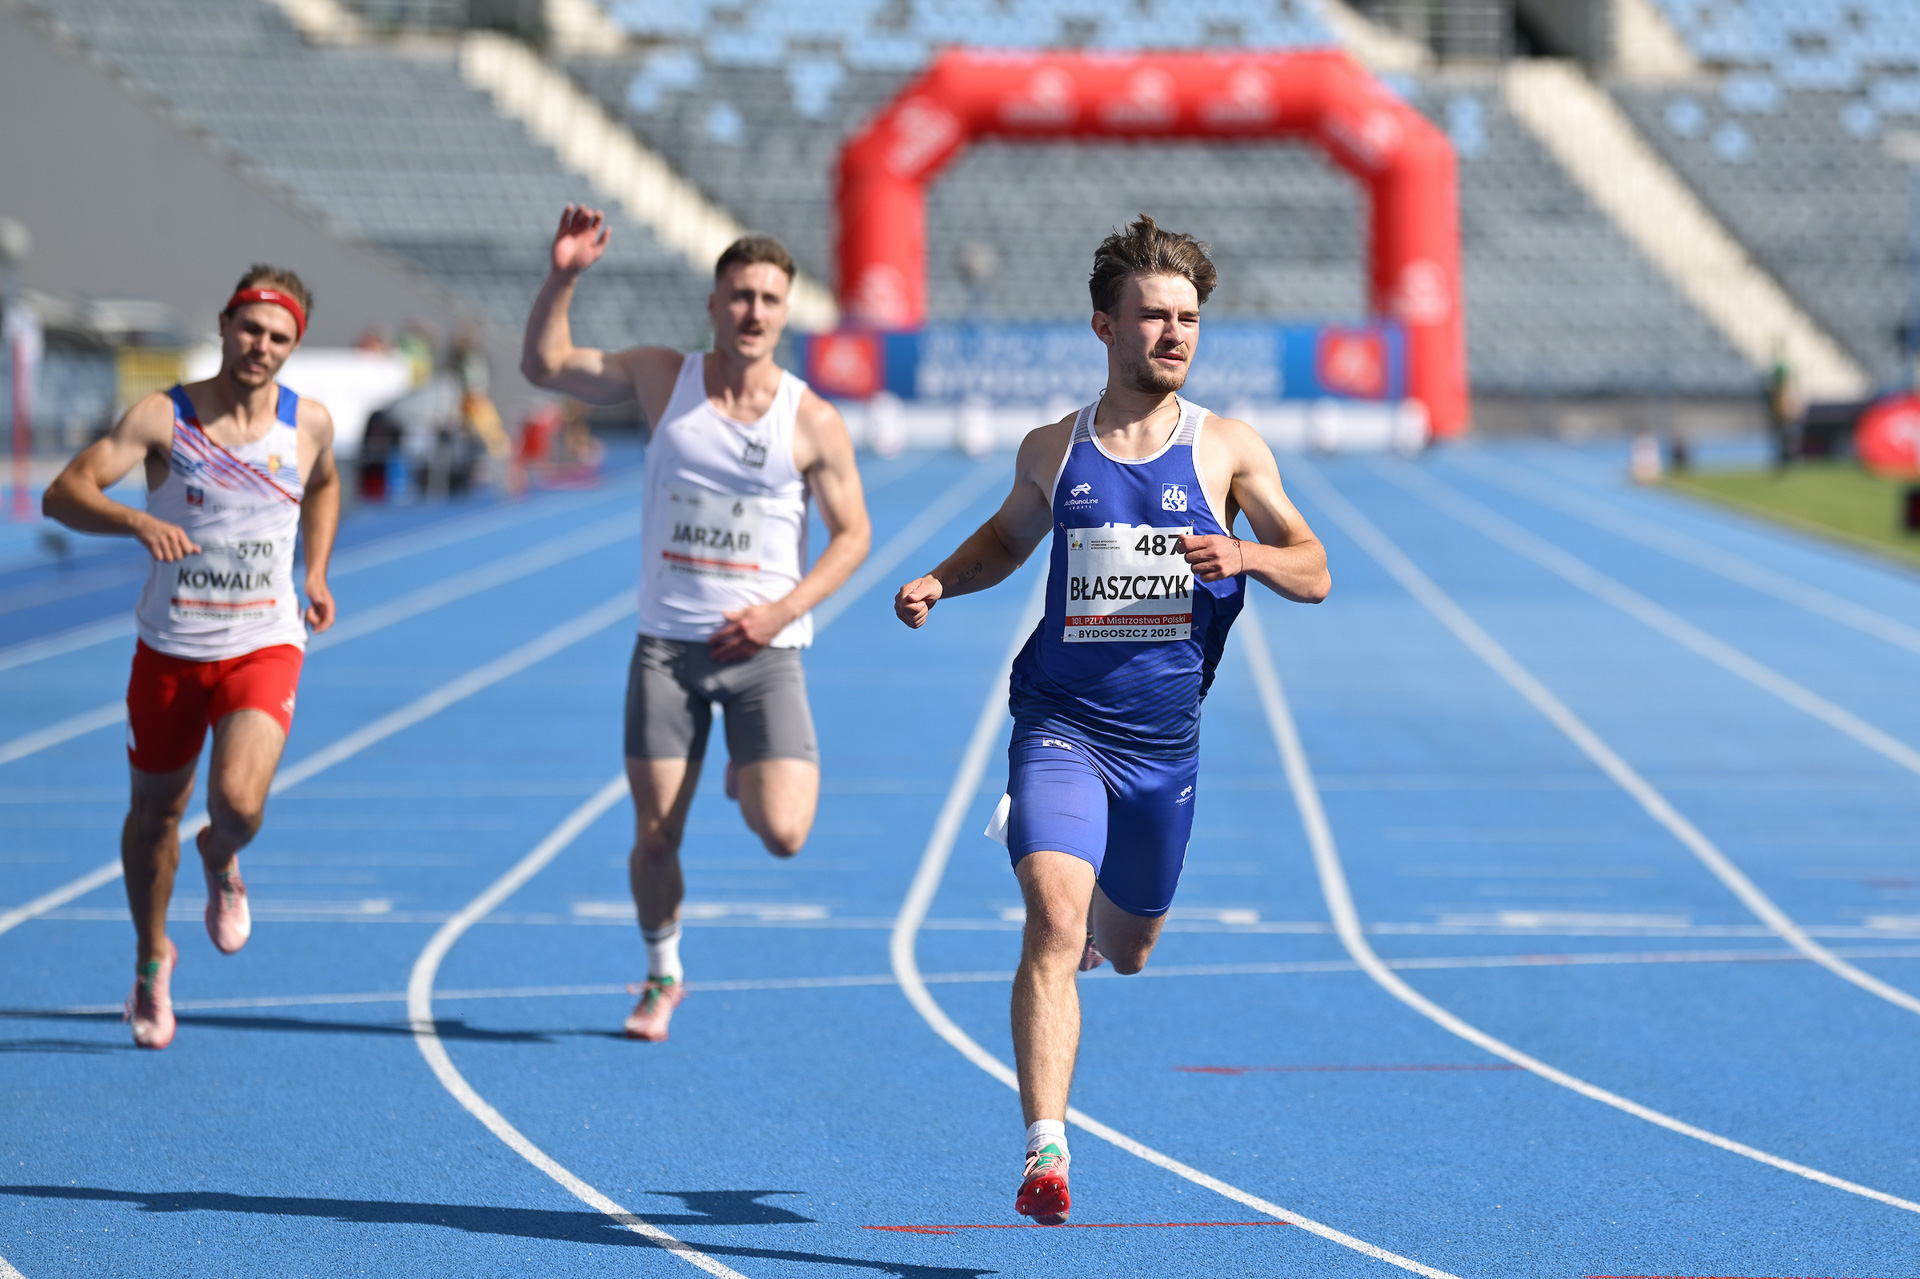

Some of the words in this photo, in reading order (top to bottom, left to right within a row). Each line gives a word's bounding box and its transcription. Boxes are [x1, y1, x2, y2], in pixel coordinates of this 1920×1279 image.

[732, 500, 744, 518] 6
[237, 540, 273, 560] 570
[1134, 534, 1181, 556] 487
[177, 567, 273, 592] KOWALIK
[1070, 574, 1190, 601] BŁASZCZYK
[1106, 615, 1161, 625] Mistrzostwa
[1162, 614, 1186, 624] Polski
[1078, 629, 1149, 639] BYDGOSZCZ
[1150, 628, 1177, 638] 2025
